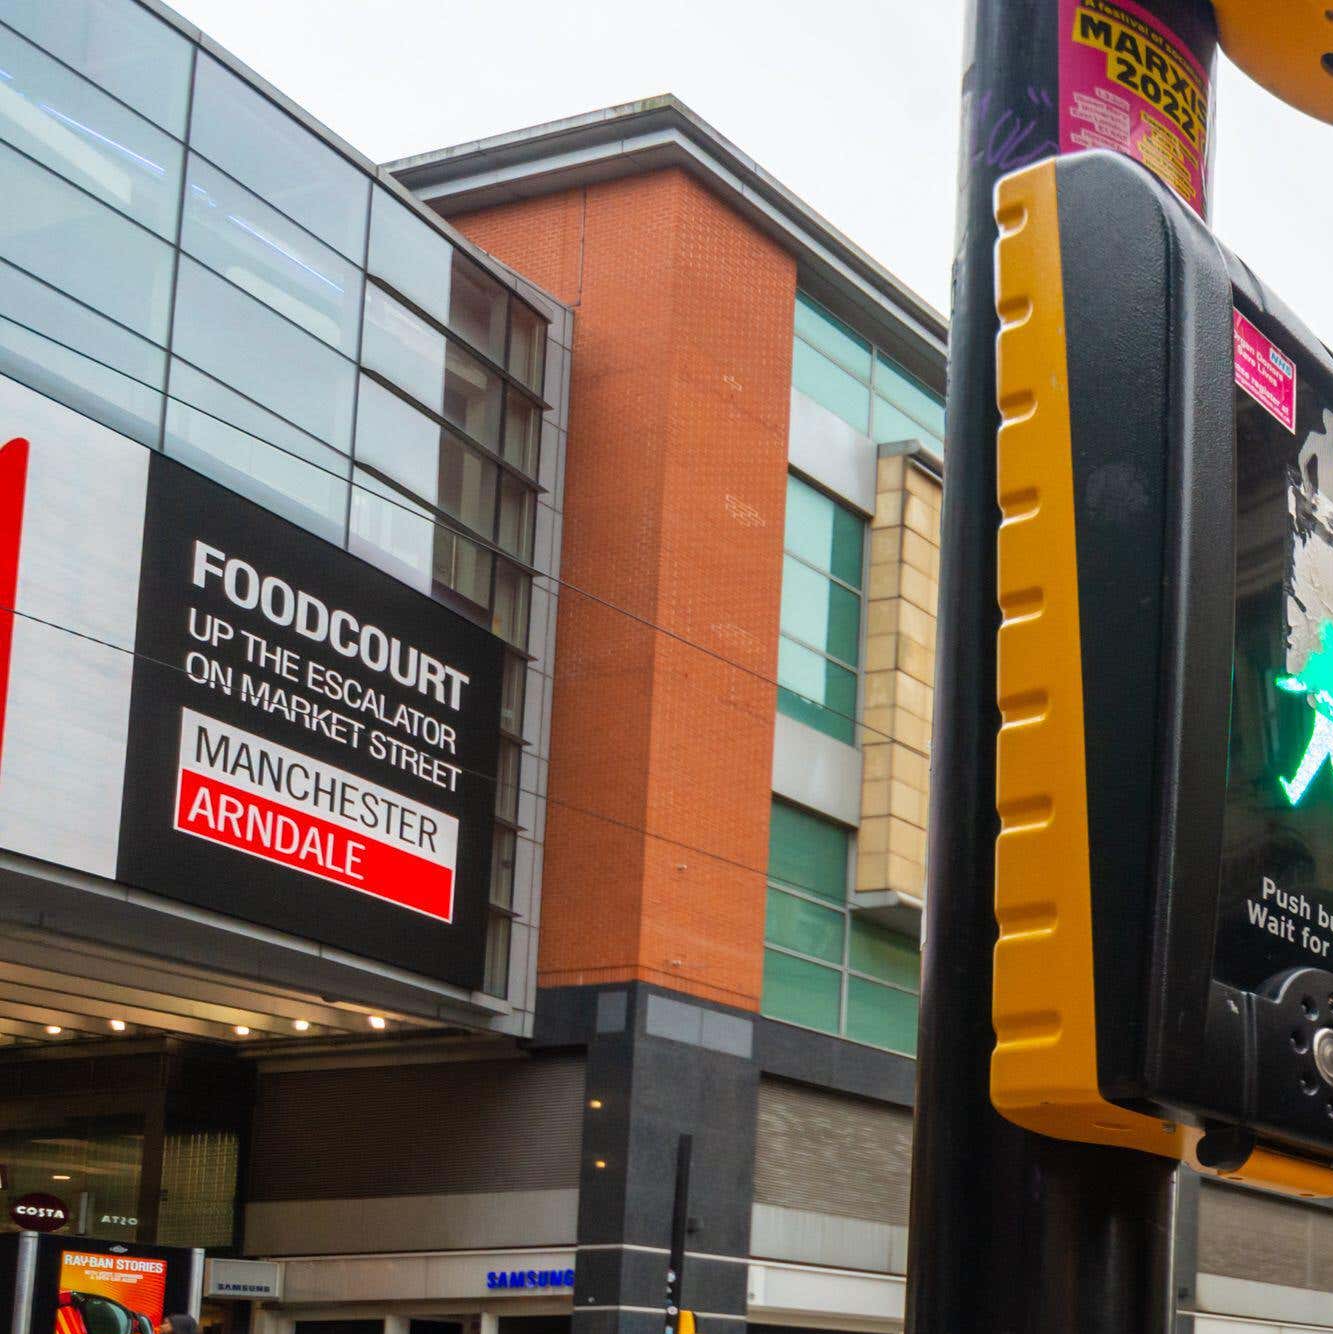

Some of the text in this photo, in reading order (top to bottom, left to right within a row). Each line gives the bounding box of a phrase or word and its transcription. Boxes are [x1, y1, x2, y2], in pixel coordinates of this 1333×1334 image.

[1080, 13, 1207, 134] MARXIS
[1116, 57, 1196, 143] 2022
[1257, 362, 1278, 387] Lives
[1270, 350, 1292, 379] NHS
[192, 539, 470, 712] FOODCOURT
[188, 607, 457, 756] UP THE ESCALATOR
[186, 653, 463, 793] ON MARKET STREET
[194, 724, 438, 853] MANCHESTER
[187, 784, 366, 882] ARNDALE
[1262, 876, 1311, 920] Push
[1247, 899, 1295, 943] Wait
[1301, 926, 1330, 957] for
[16, 1205, 65, 1219] COSTA
[116, 1259, 164, 1274] STORIES
[217, 1283, 271, 1293] SAMSUNG
[487, 1269, 575, 1289] SAMSUNG
